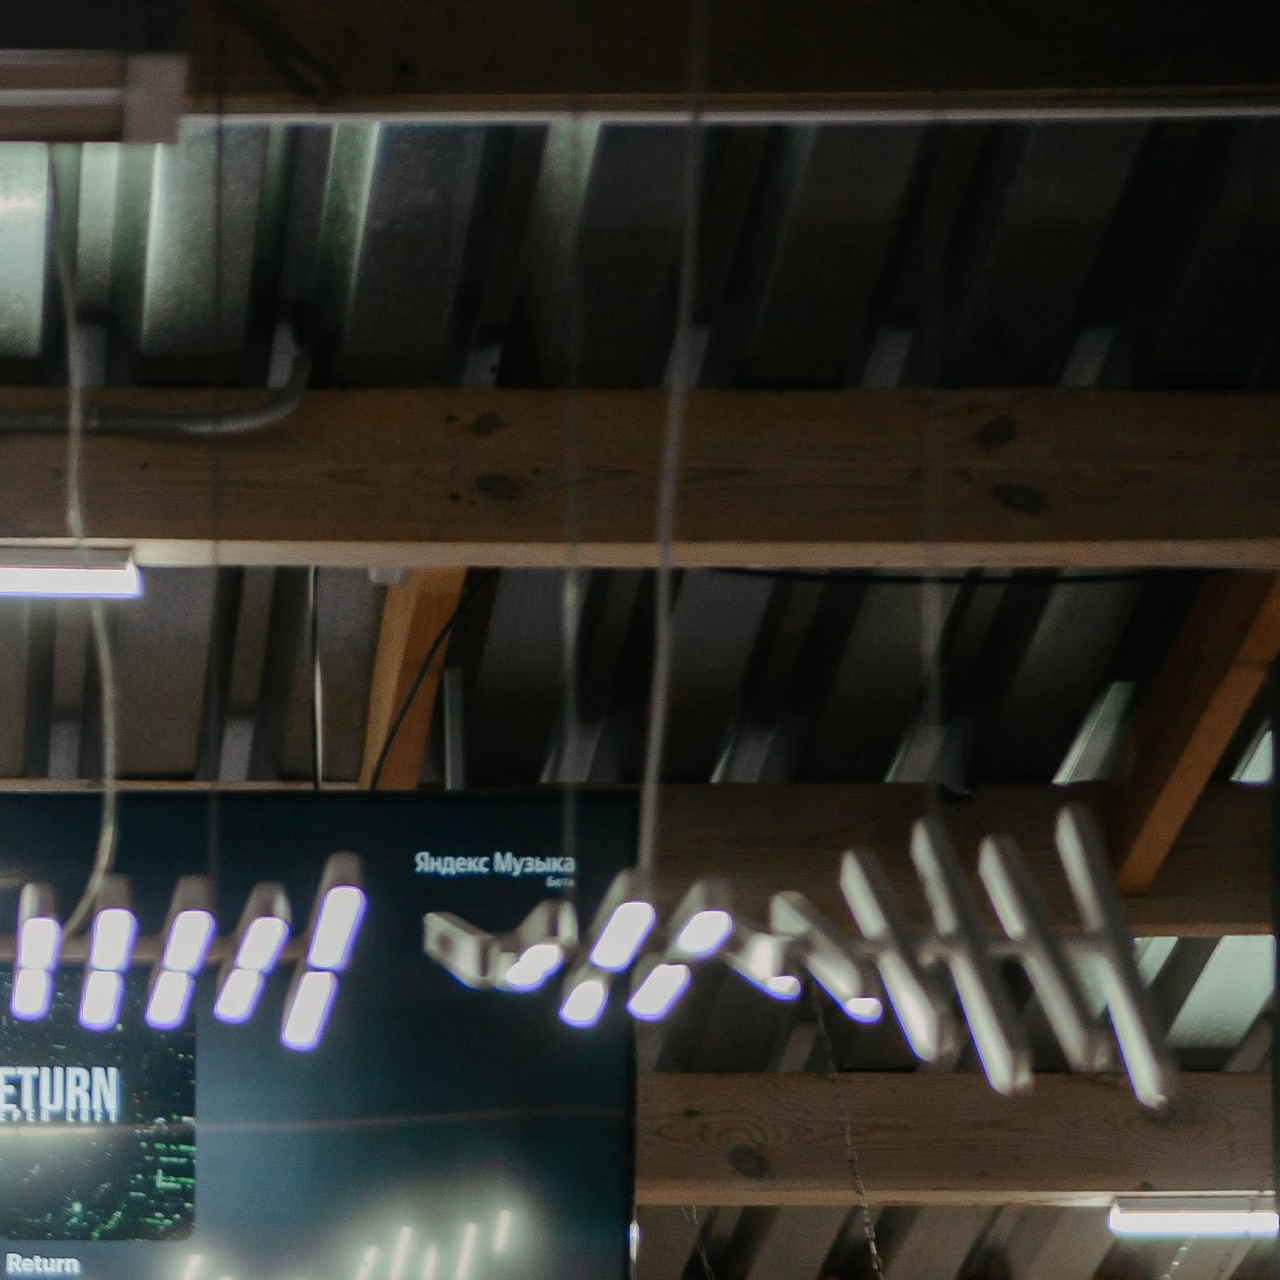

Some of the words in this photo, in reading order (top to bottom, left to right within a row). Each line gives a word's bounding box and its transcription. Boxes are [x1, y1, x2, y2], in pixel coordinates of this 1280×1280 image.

[414, 851, 490, 876] Яндекс
[493, 851, 576, 877] Музыка
[66, 1108, 118, 1123] LOFT
[5, 1252, 82, 1274] Return
